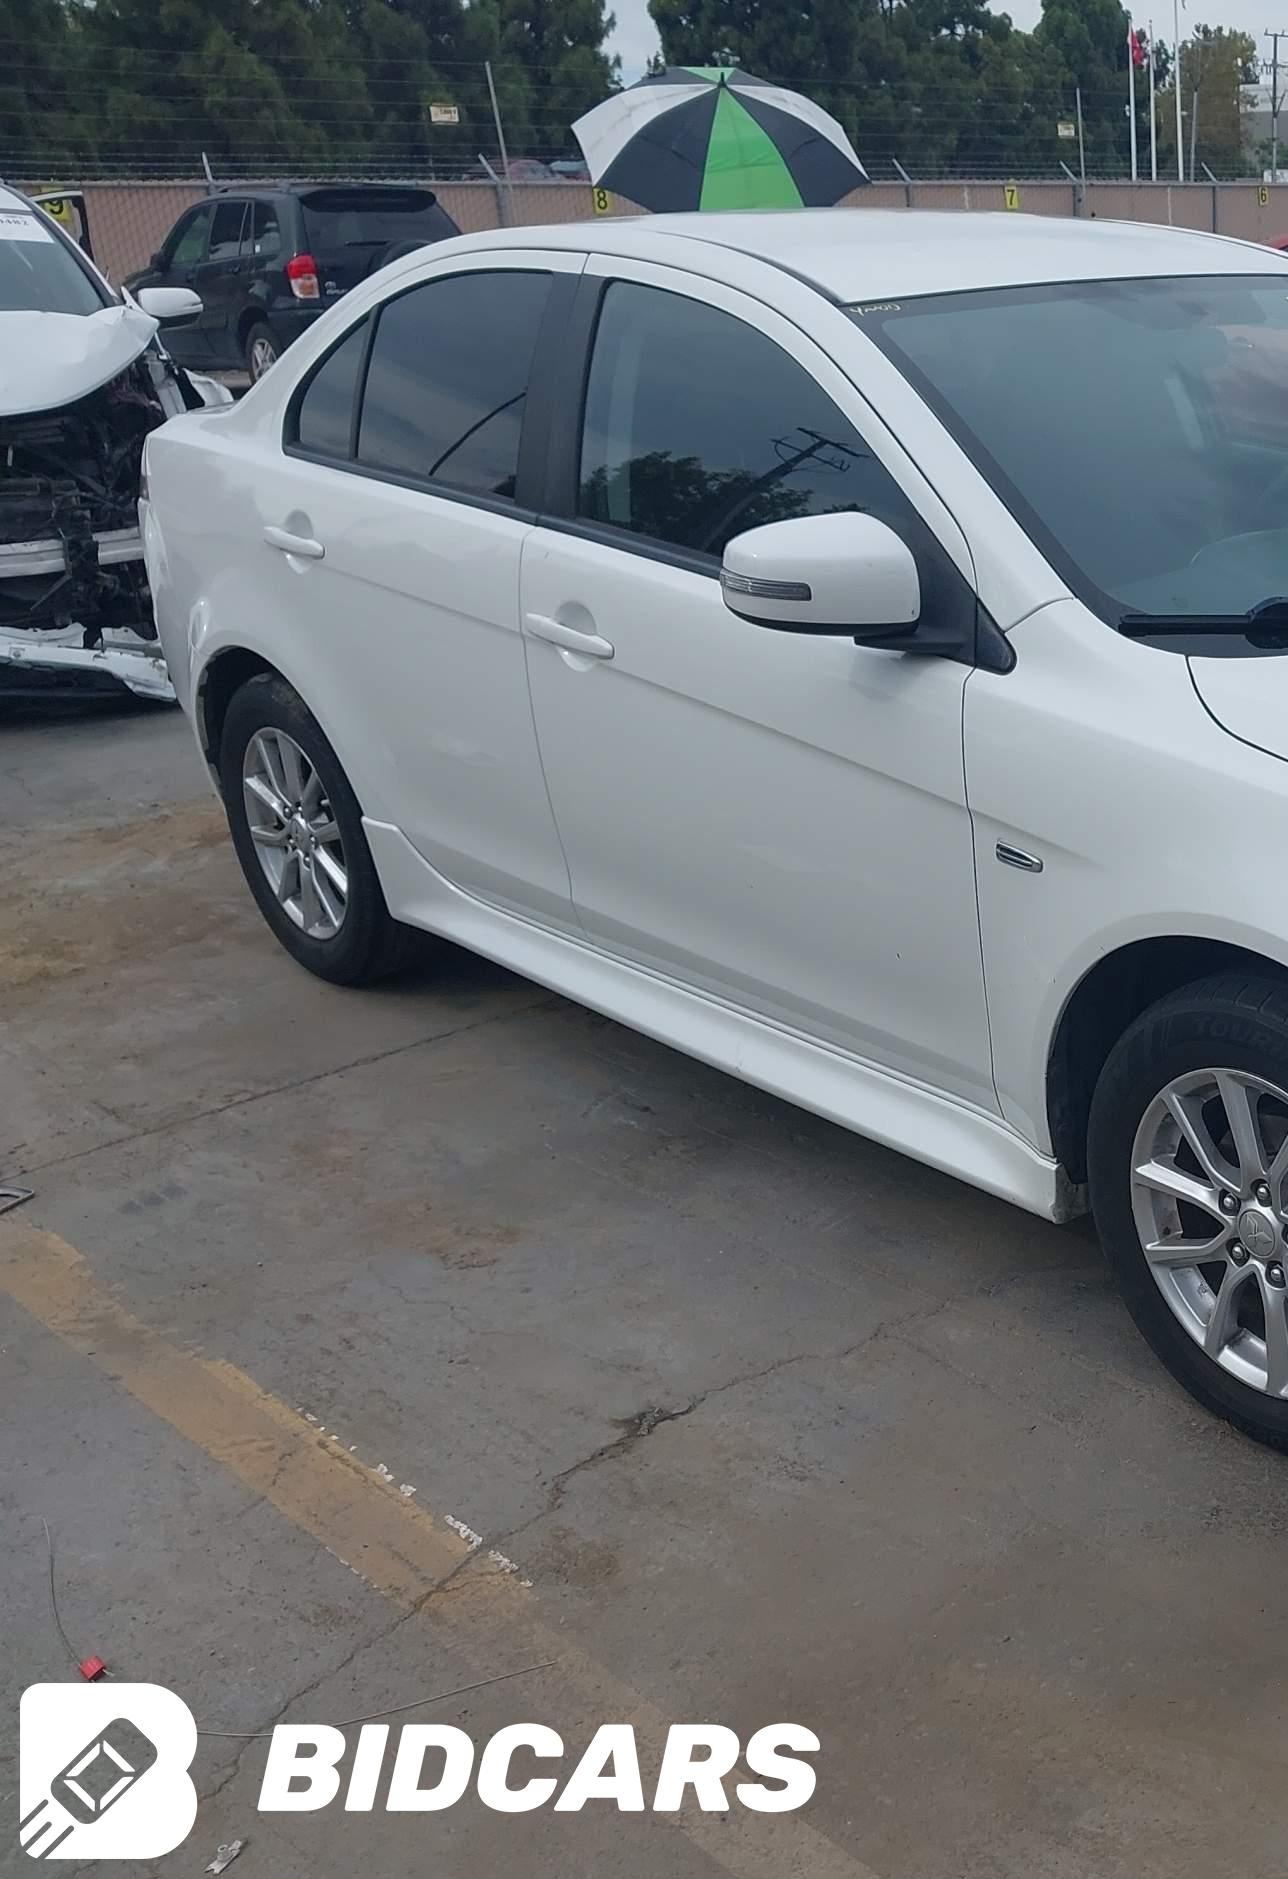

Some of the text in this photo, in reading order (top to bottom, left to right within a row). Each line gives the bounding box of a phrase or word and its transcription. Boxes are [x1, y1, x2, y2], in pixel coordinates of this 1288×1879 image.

[597, 189, 608, 210] 8
[1006, 189, 1015, 206] 7
[1260, 187, 1267, 203] 6
